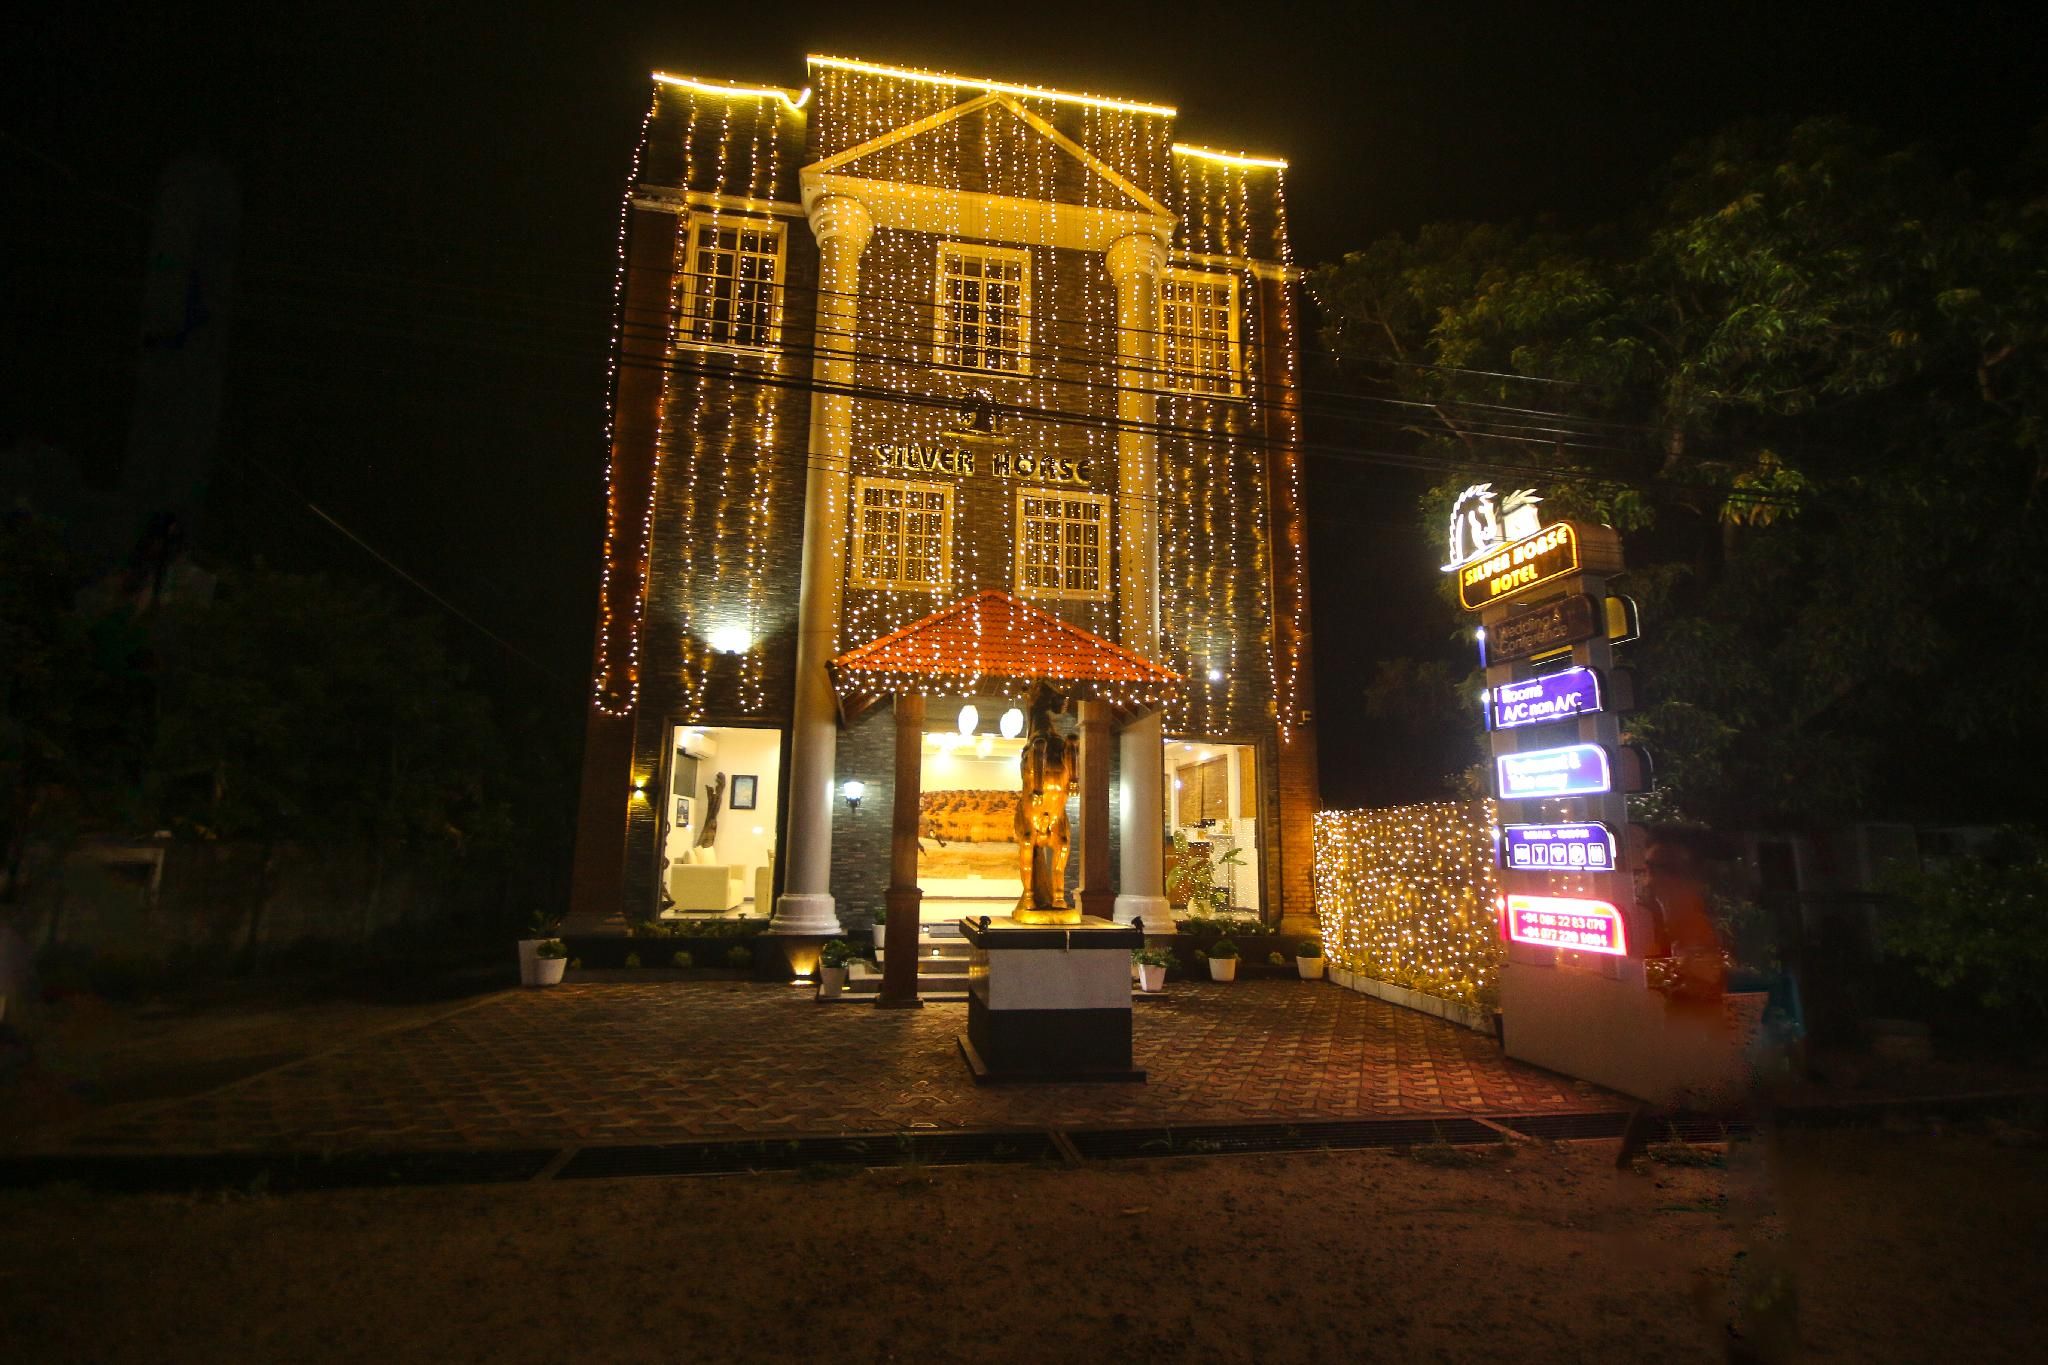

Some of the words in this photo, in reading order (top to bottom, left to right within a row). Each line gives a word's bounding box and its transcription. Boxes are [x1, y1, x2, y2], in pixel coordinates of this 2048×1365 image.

[877, 444, 976, 476] SILVER
[993, 452, 1092, 485] HORSE
[1464, 554, 1510, 587] SILVER
[1514, 527, 1568, 565] HORSE
[1491, 564, 1538, 596] HOTEL
[1501, 685, 1544, 704] Rooms
[1504, 703, 1529, 721] A/C
[1529, 701, 1554, 716] non
